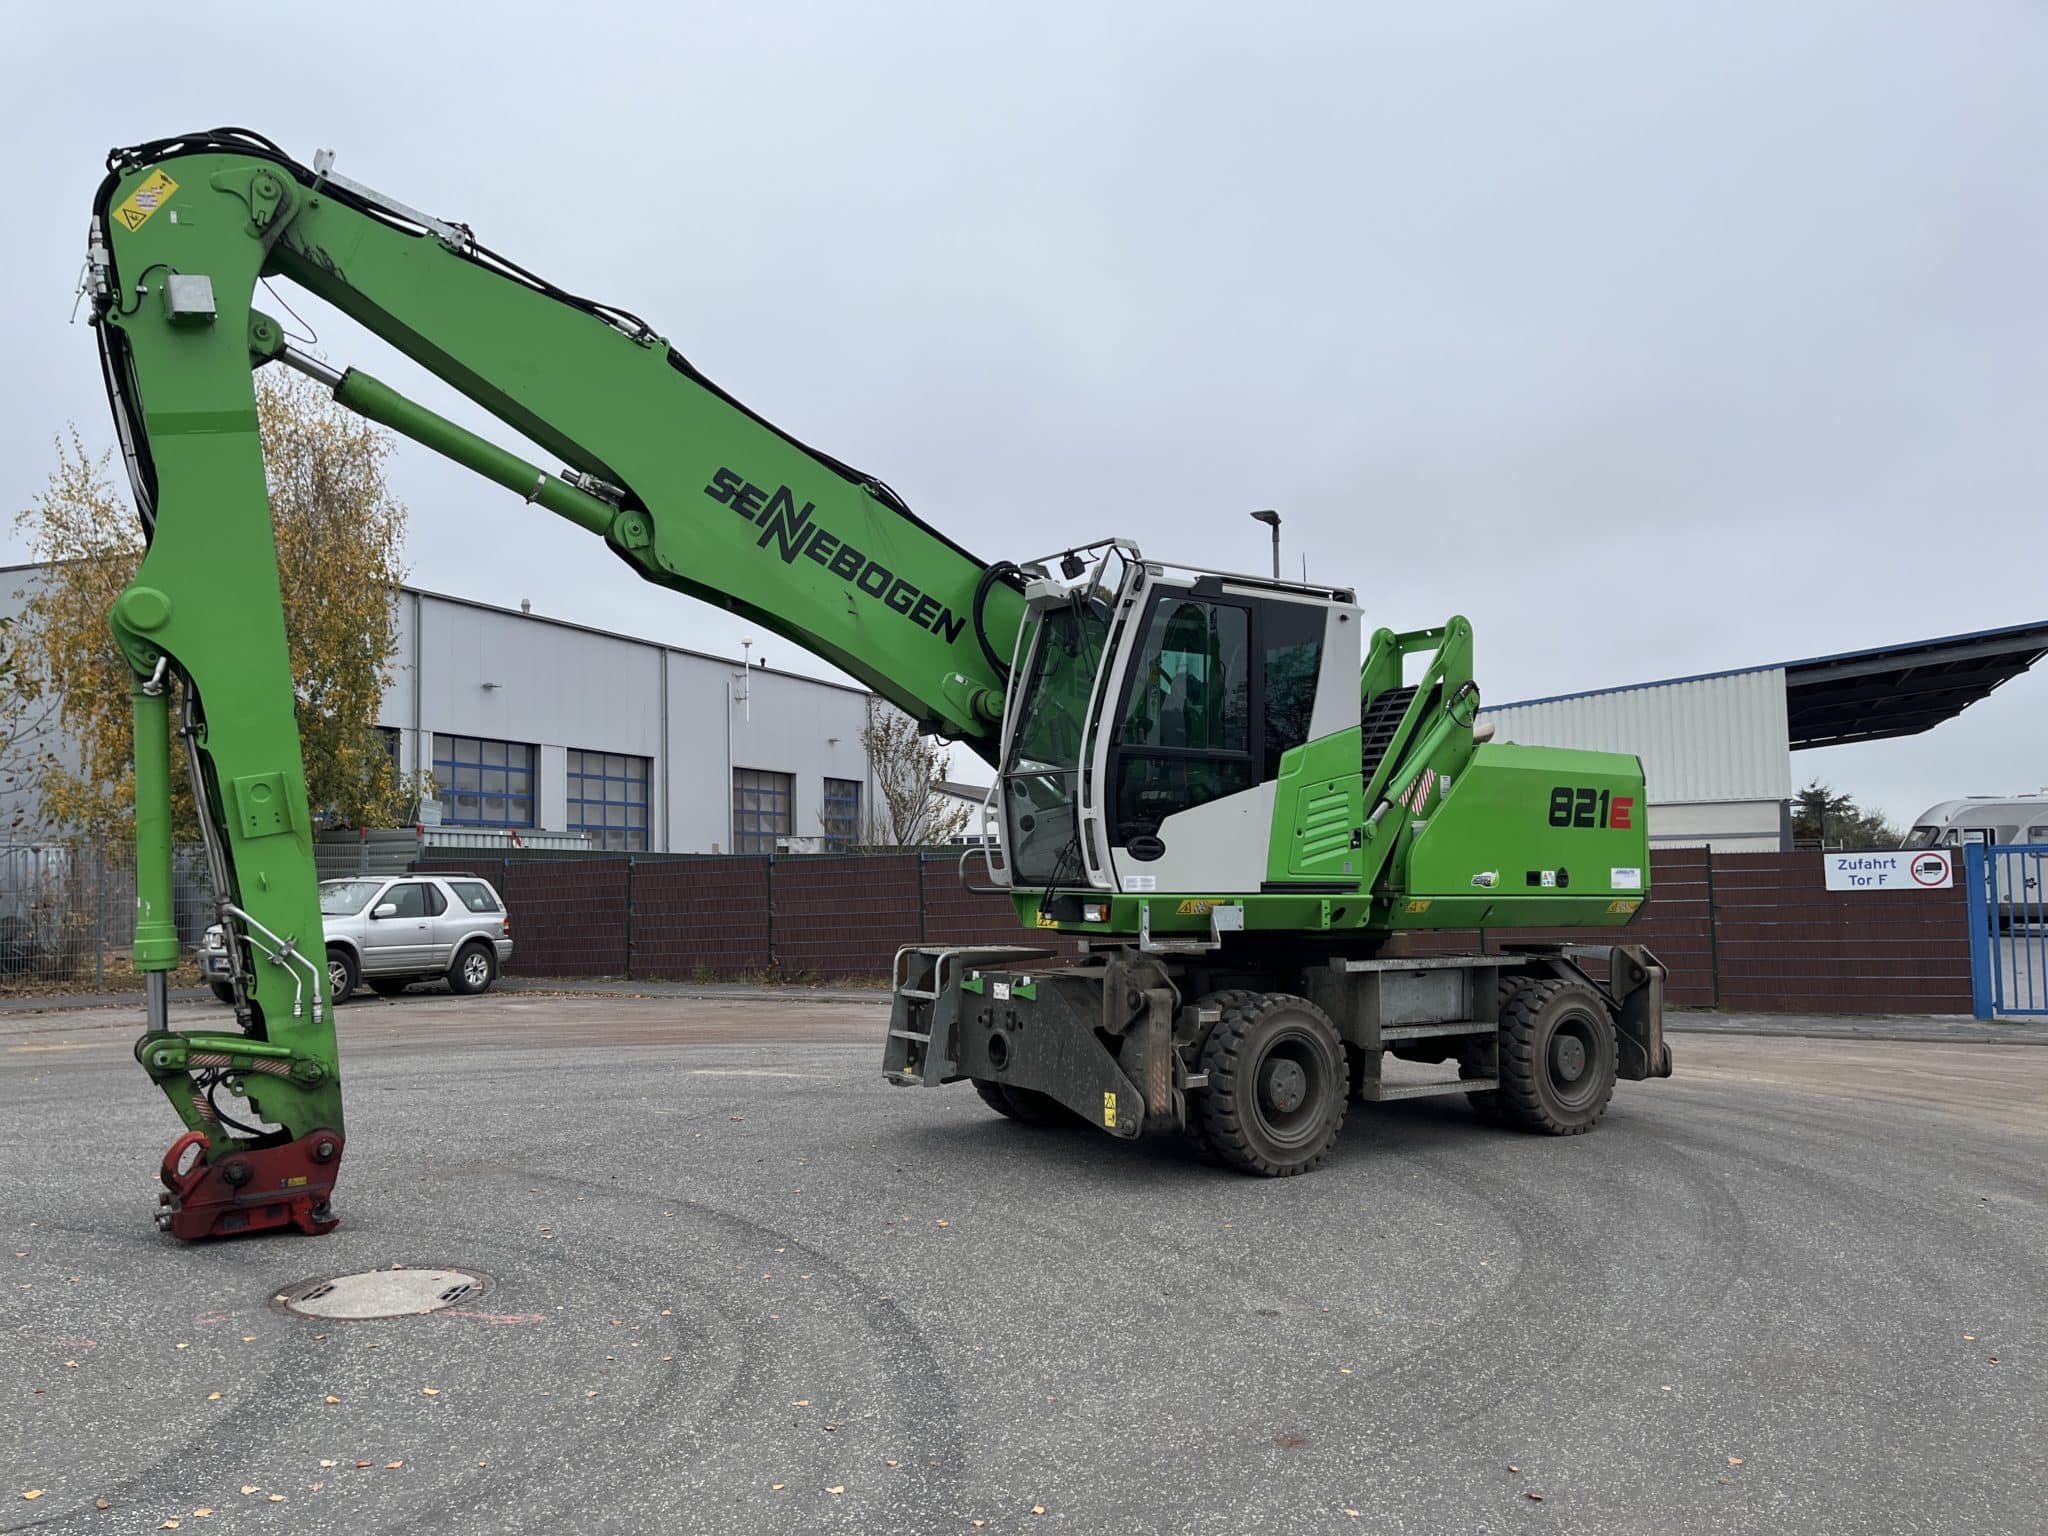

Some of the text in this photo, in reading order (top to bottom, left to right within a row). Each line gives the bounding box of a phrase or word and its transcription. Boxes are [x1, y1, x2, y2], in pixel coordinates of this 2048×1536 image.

[704, 466, 967, 645] SENNEBOGEN
[1548, 786, 1634, 829] 821E
[1838, 858, 1897, 871] Zufahrt
[1848, 873, 1888, 886] Tor F
